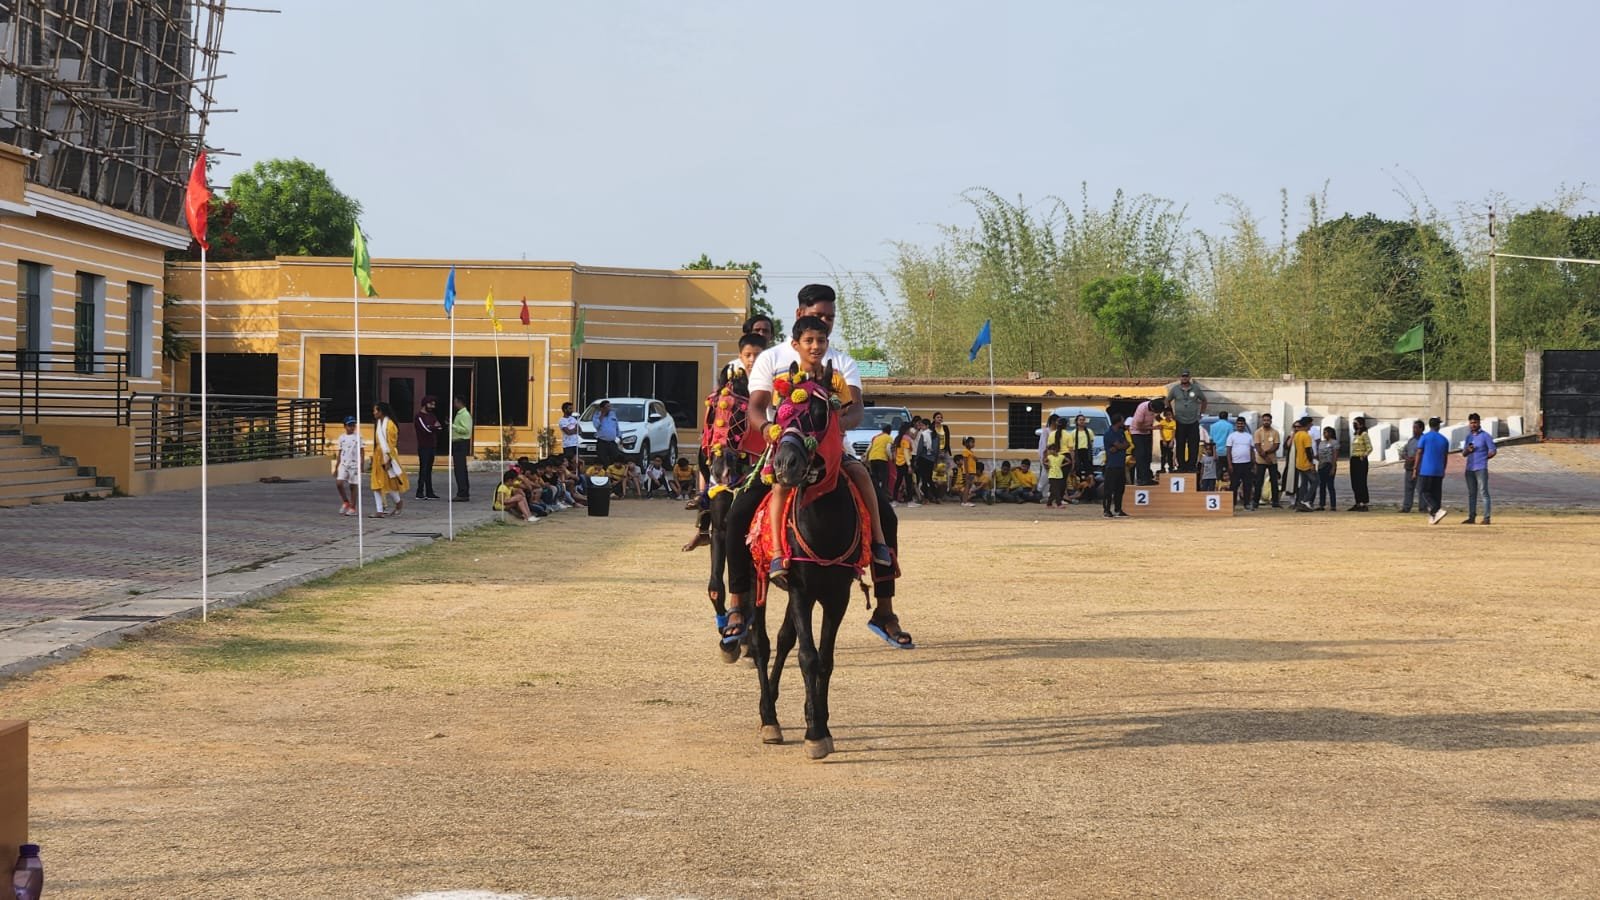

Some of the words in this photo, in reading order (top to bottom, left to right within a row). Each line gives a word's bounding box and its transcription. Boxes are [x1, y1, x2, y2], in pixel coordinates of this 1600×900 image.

[1173, 481, 1180, 491] 1
[1137, 493, 1146, 504] 2
[1208, 498, 1217, 509] 3
